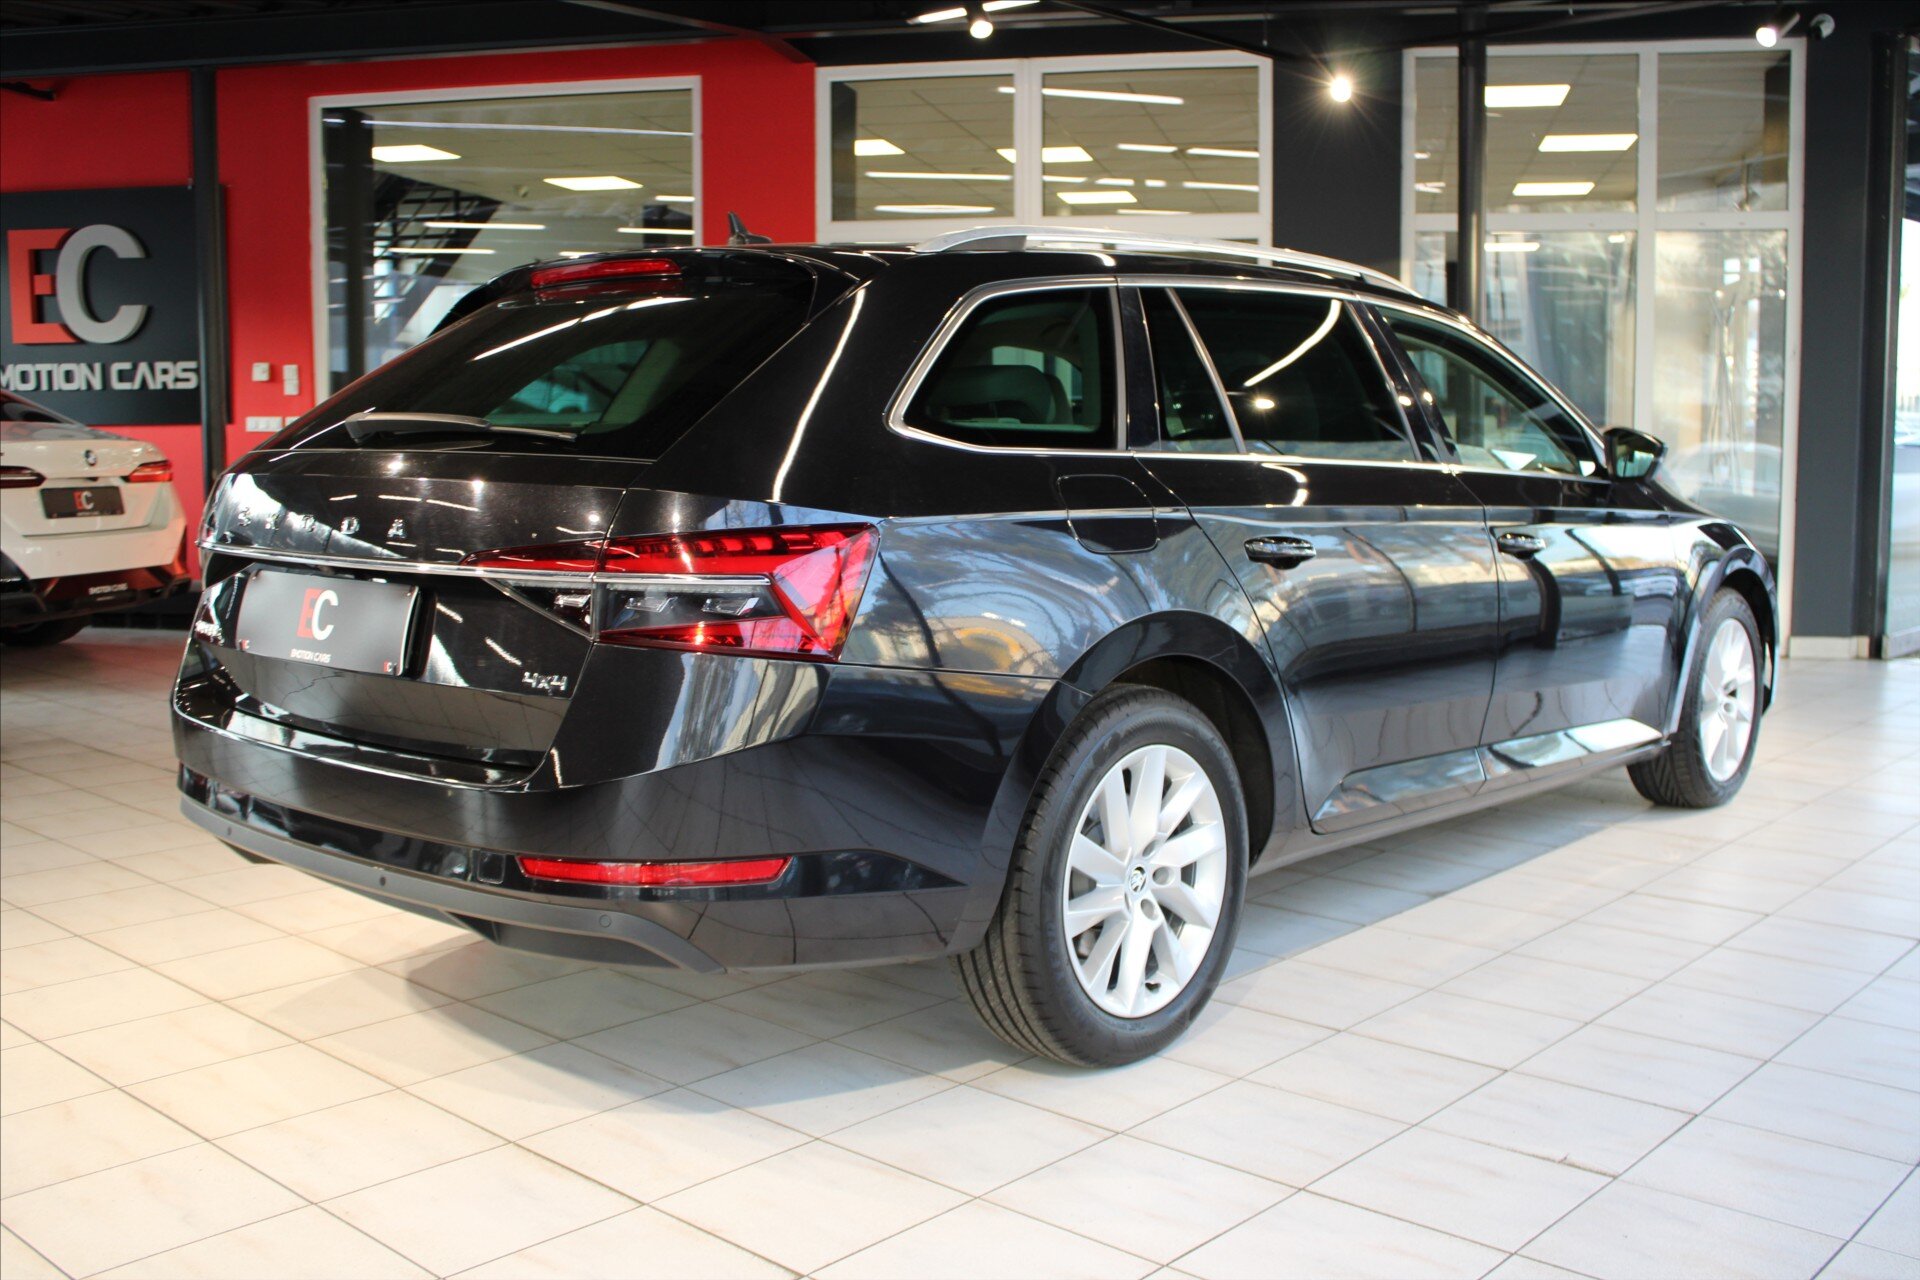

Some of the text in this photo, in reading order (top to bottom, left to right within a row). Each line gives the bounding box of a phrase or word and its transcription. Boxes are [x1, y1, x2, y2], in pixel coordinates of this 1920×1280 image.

[7, 224, 149, 344] EC
[110, 361, 199, 390] CARS
[297, 588, 338, 641] EC
